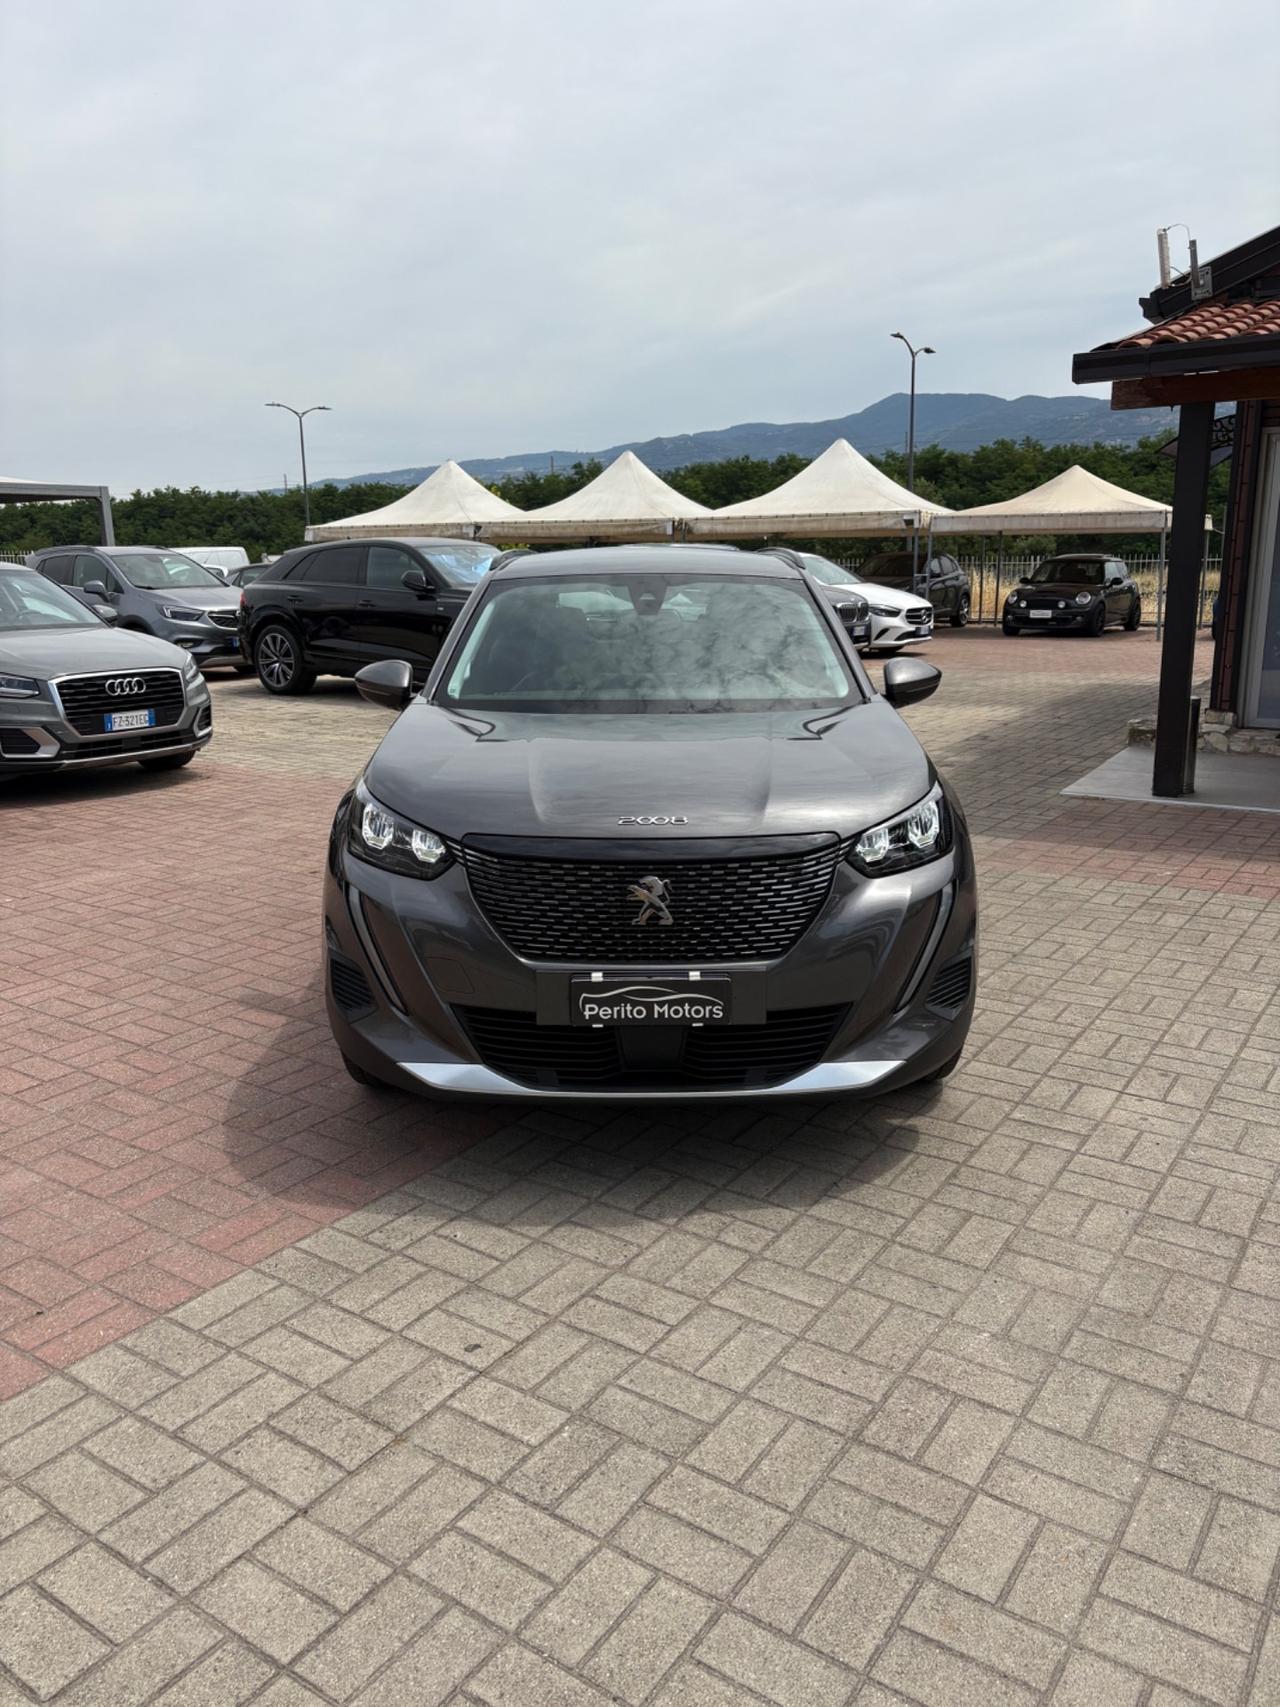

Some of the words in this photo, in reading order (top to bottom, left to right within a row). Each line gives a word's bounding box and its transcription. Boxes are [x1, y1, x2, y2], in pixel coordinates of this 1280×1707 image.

[618, 816, 688, 826] 2008
[584, 1003, 647, 1020] Perito
[653, 1003, 724, 1019] Motors
